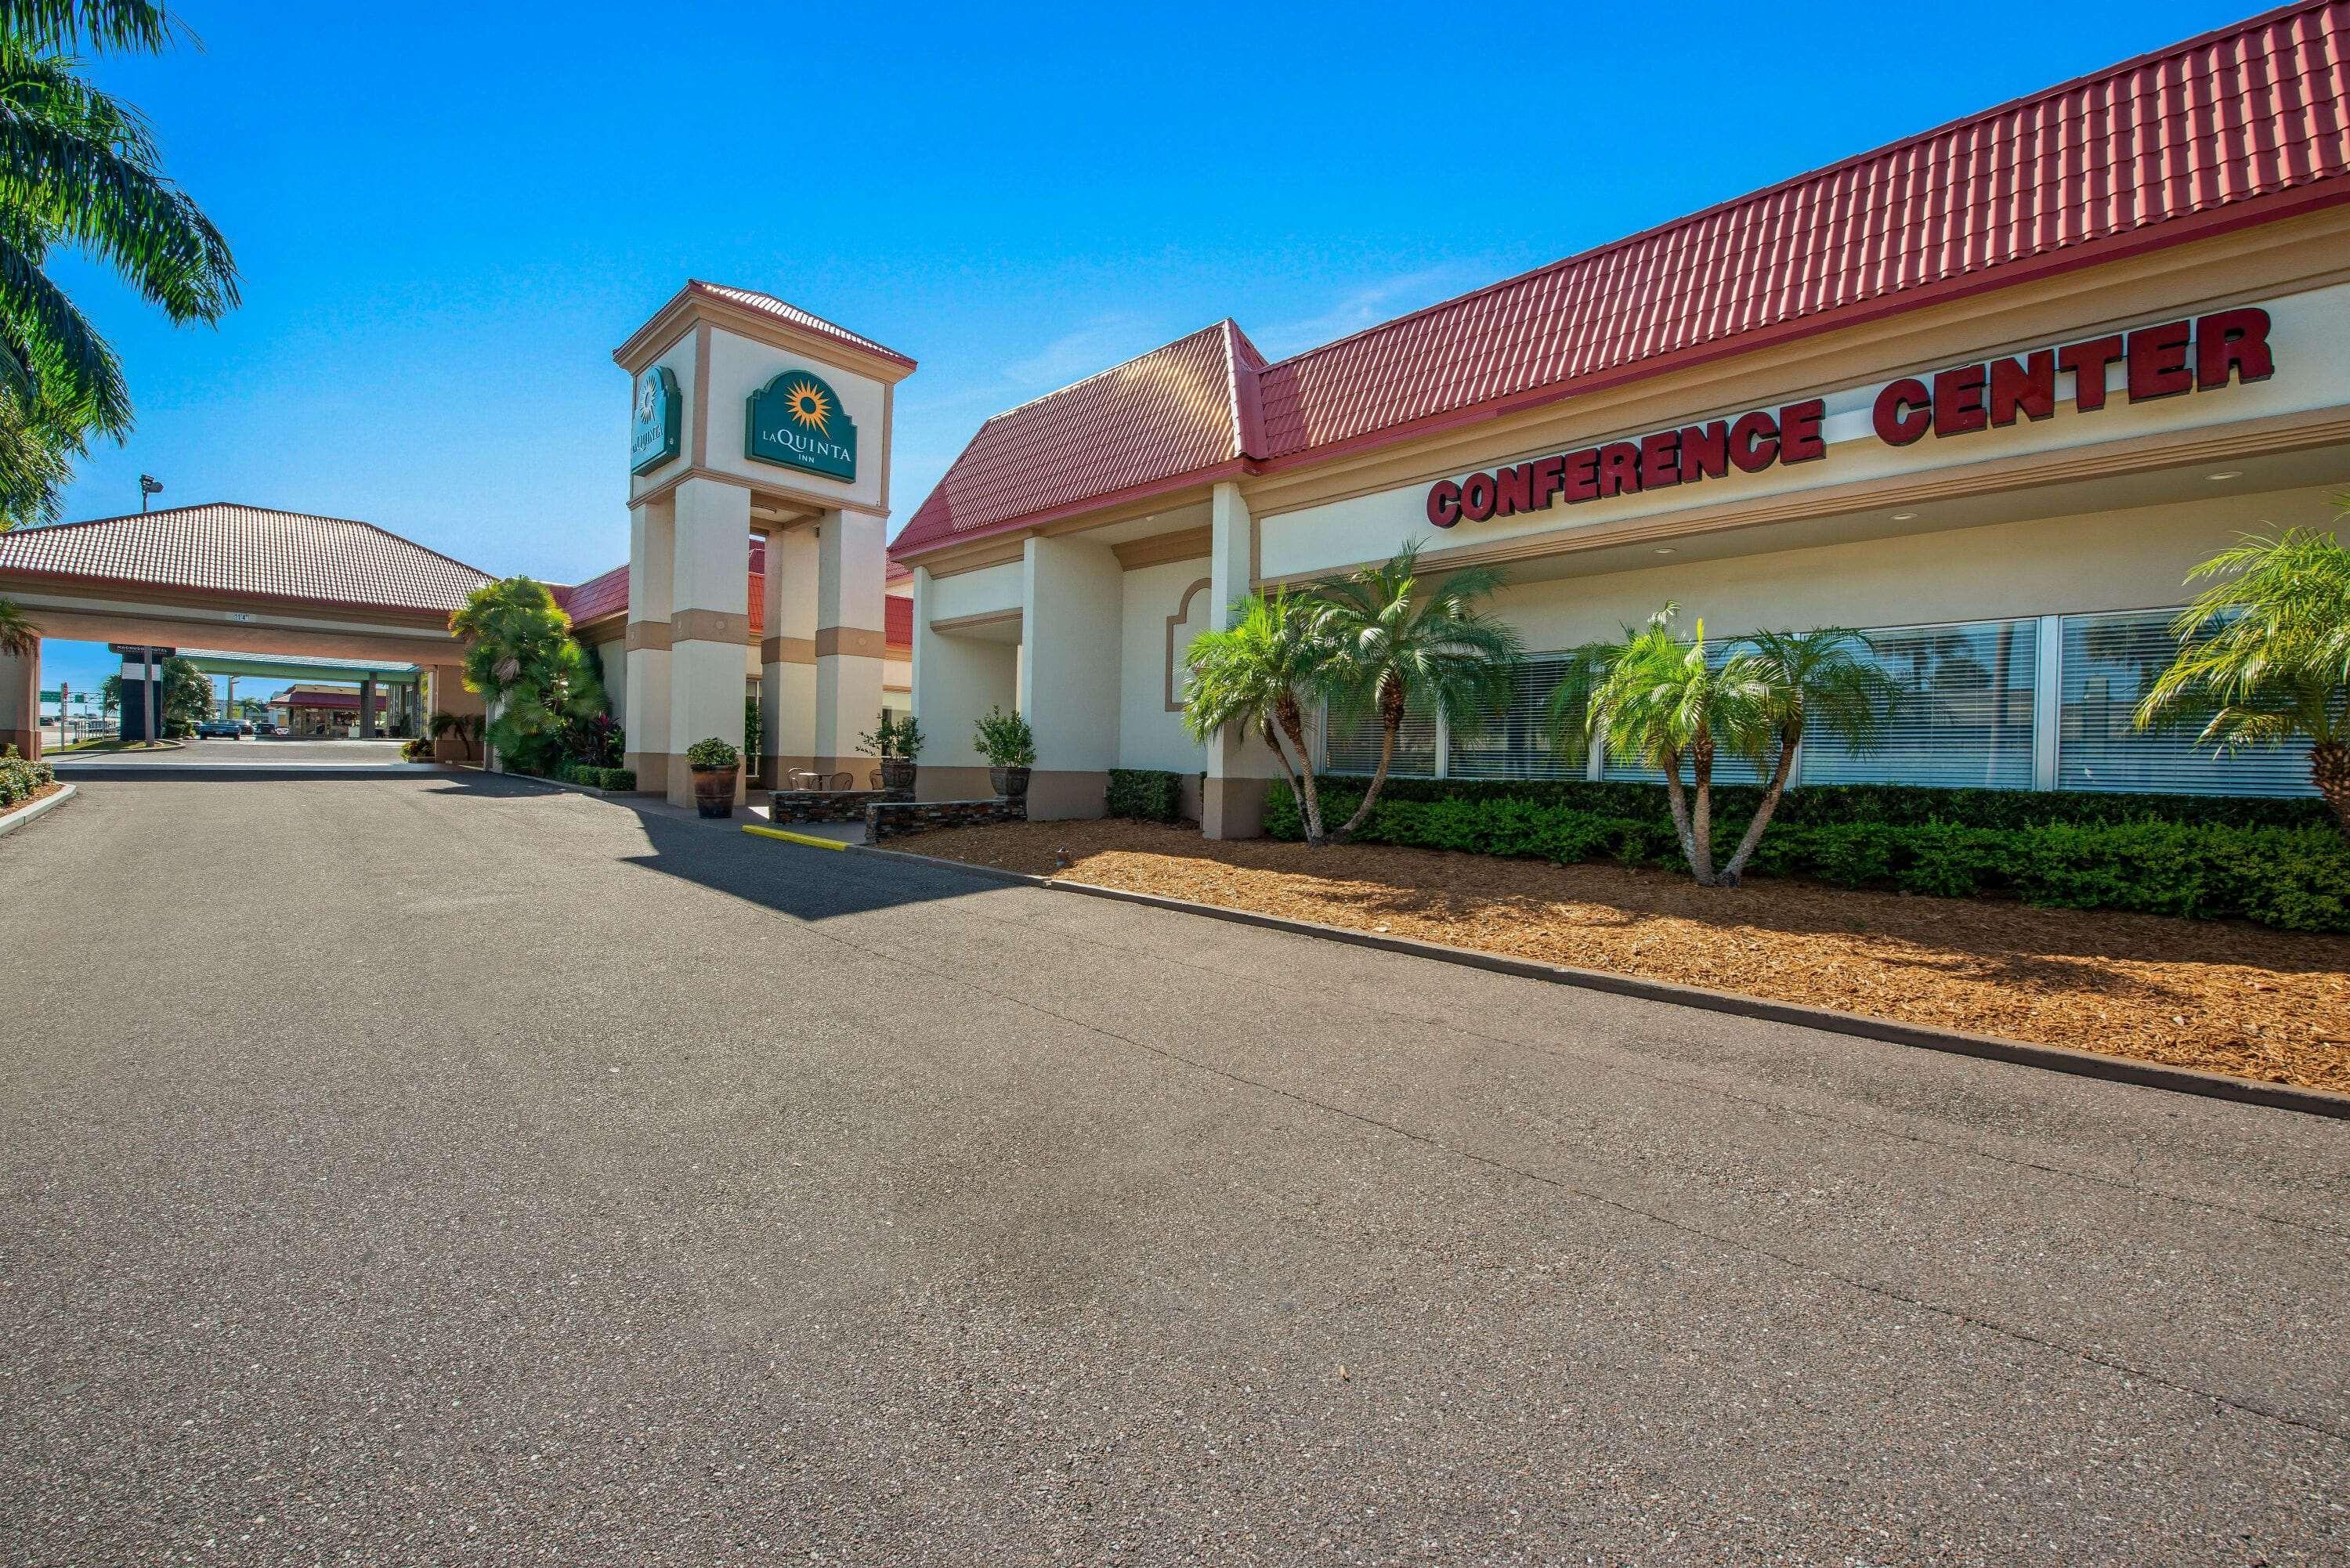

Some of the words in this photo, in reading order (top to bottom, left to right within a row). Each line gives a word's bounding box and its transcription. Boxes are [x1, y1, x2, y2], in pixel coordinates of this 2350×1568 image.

[1426, 398, 1826, 529] CONFERENCE
[1873, 307, 2275, 446] CENTER
[763, 430, 776, 443] LA
[777, 428, 852, 462] QUINTA
[798, 453, 815, 464] INN
